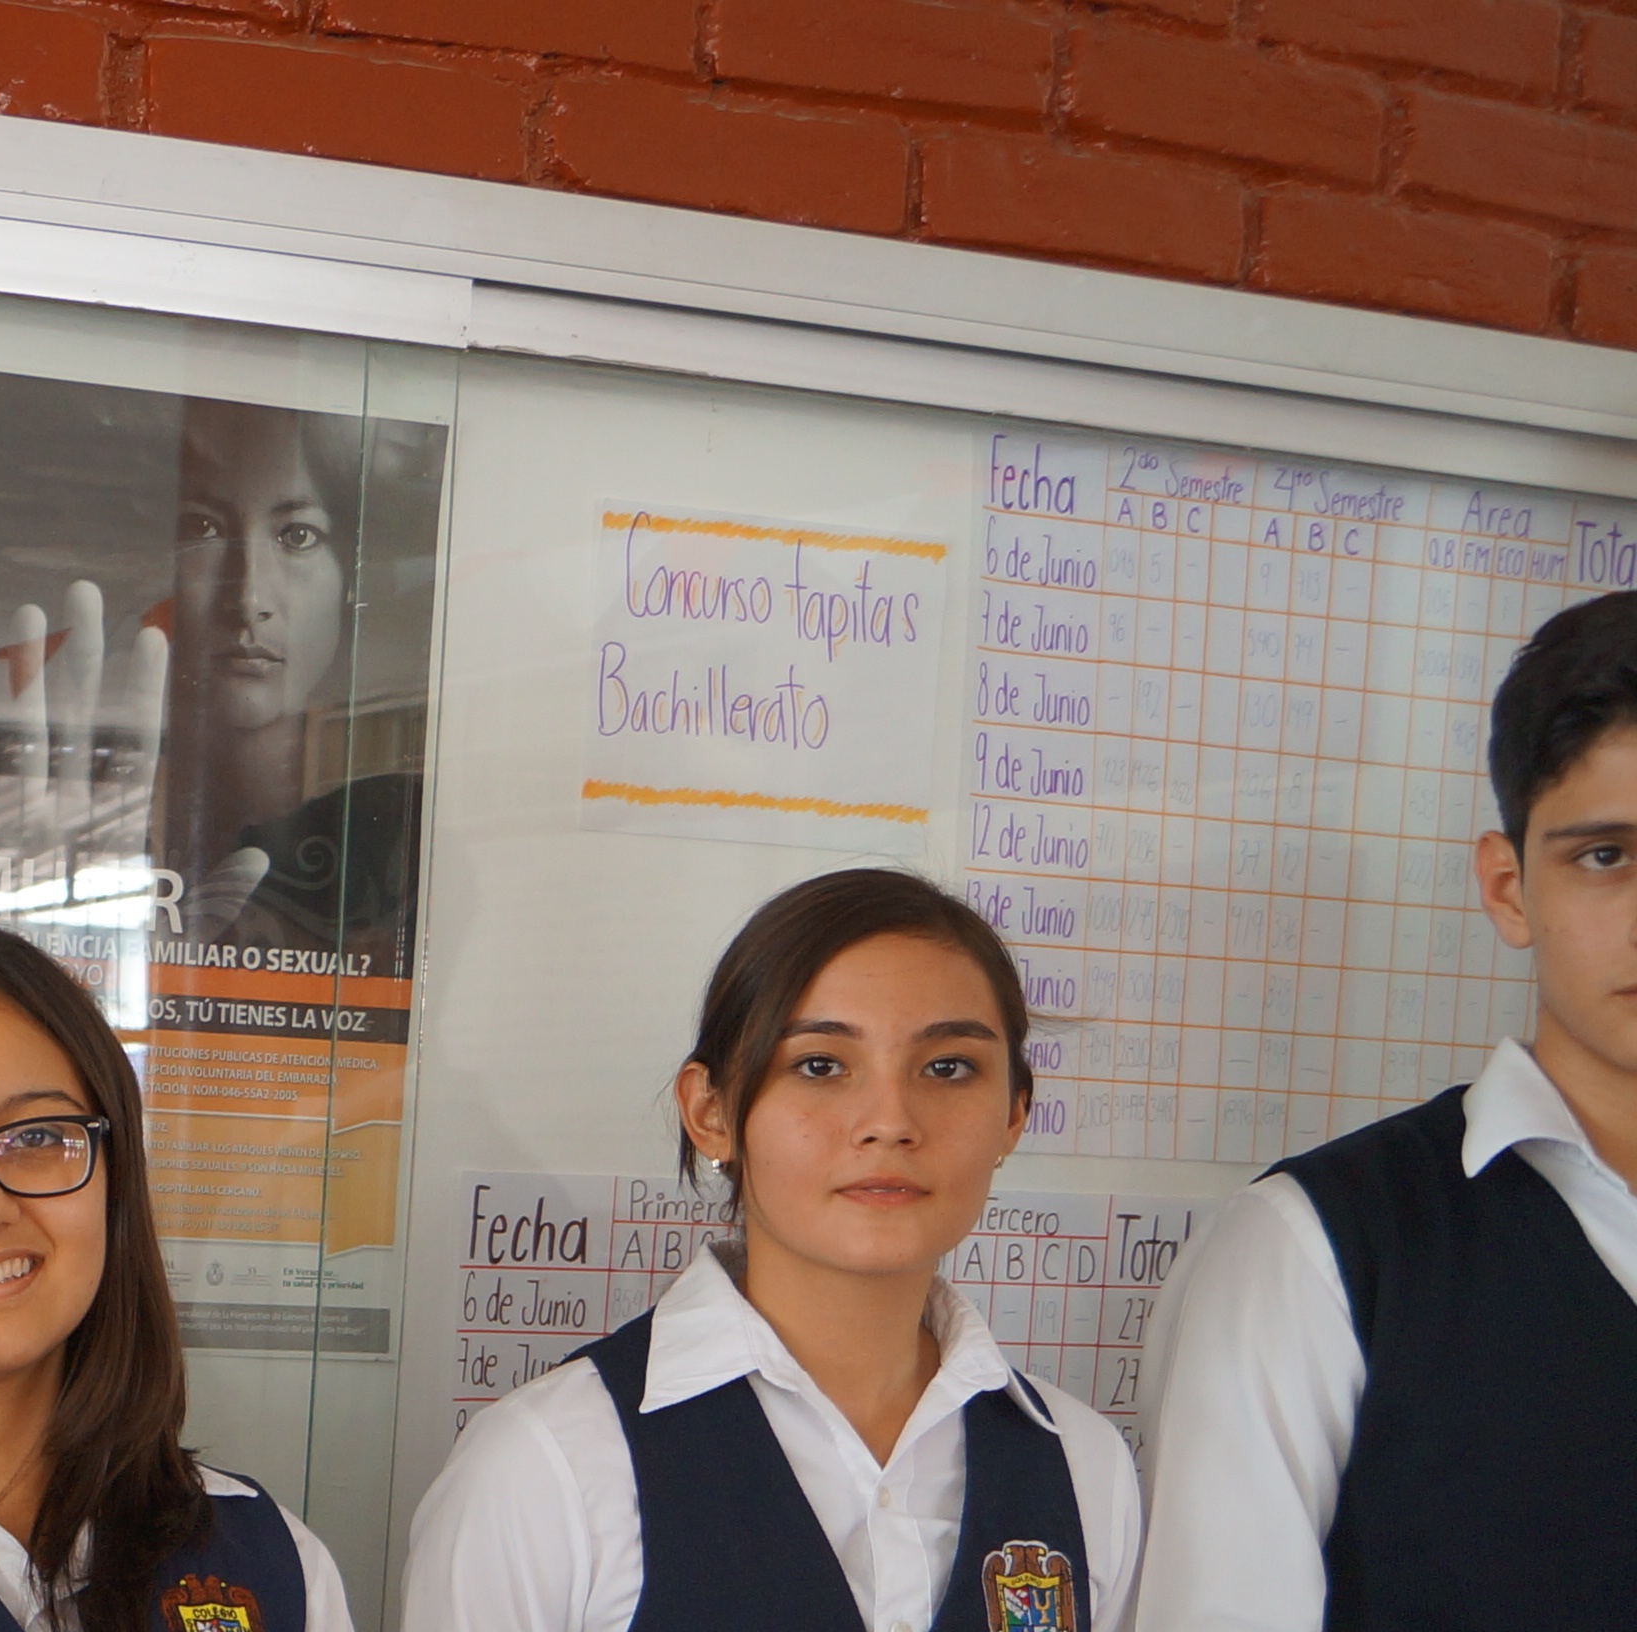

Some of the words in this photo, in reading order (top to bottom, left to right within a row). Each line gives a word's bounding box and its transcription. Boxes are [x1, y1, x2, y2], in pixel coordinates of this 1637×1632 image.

[626, 512, 771, 623] Concurso
[599, 641, 829, 749] Bachillerato
[266, 947, 371, 976] SEXUAL?
[322, 1009, 365, 1032] VOZ
